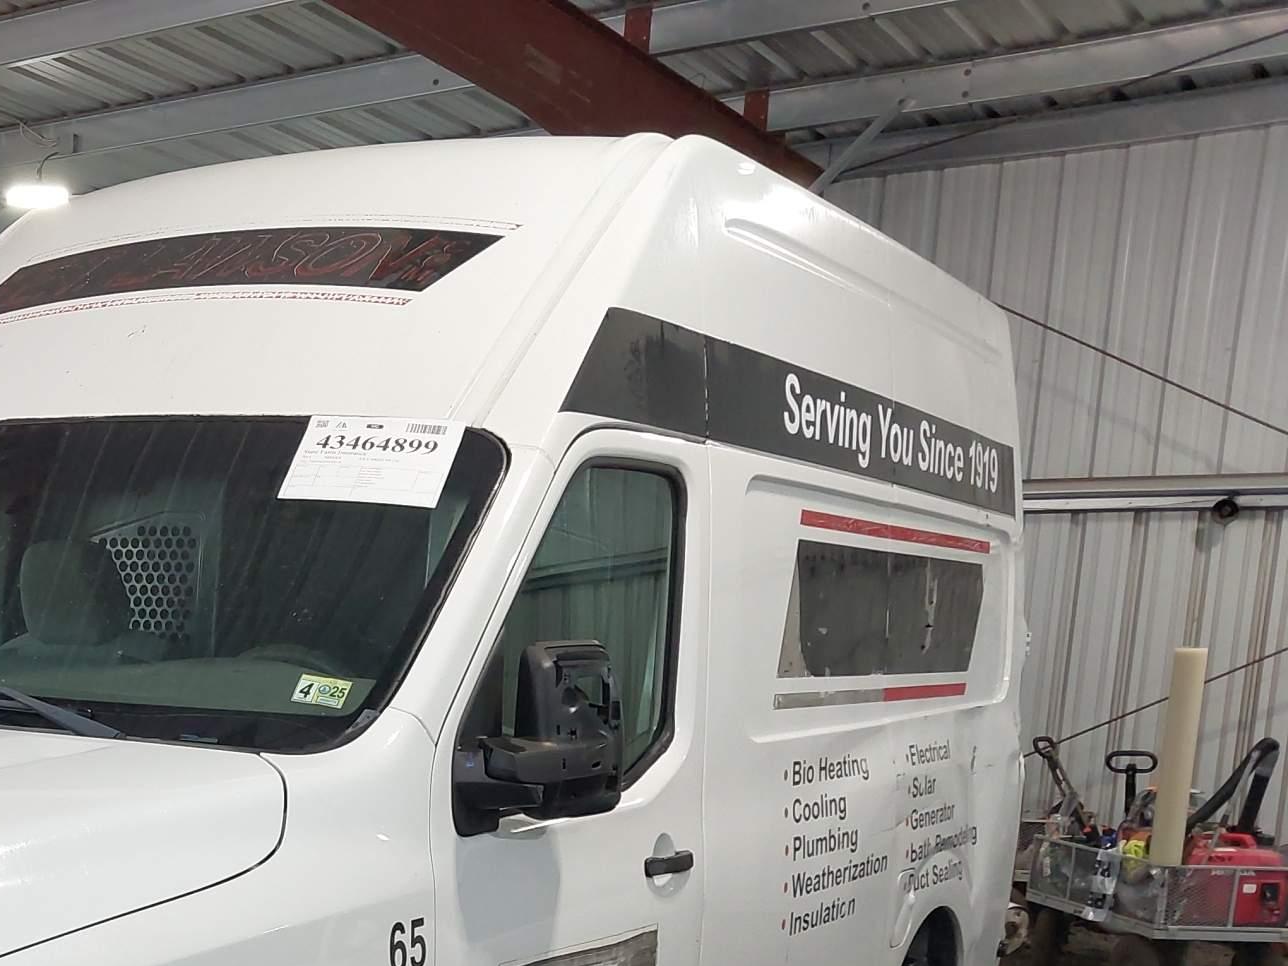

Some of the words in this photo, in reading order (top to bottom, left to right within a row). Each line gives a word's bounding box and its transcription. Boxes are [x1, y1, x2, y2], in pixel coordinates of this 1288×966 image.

[315, 434, 439, 456] 43464899
[783, 373, 872, 468] Serving
[878, 404, 913, 466] You
[918, 420, 964, 482] Since
[969, 439, 999, 493] 1919
[298, 682, 315, 698] 4
[329, 685, 348, 699] 25
[908, 739, 951, 766] Electrical
[792, 760, 814, 786] Bio
[819, 753, 870, 783] Heating
[792, 793, 847, 823] Cooling
[910, 804, 956, 830] Generator
[792, 827, 859, 861] Plumbing
[791, 853, 888, 898] Weatherization
[789, 897, 856, 936] Insulation
